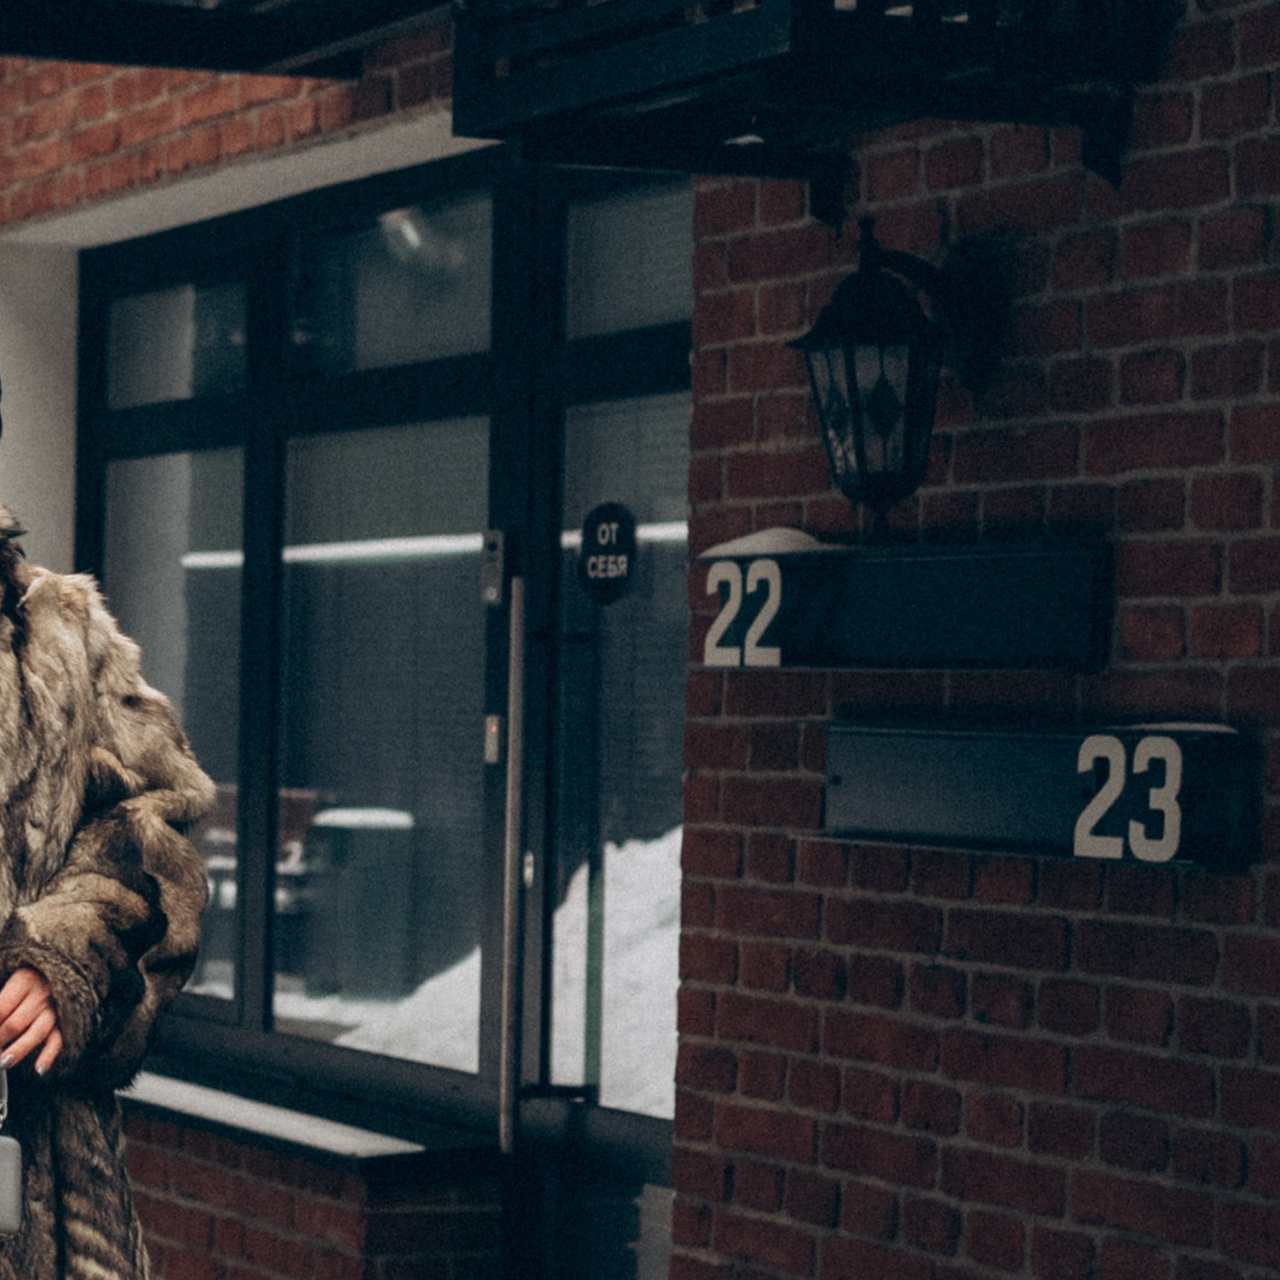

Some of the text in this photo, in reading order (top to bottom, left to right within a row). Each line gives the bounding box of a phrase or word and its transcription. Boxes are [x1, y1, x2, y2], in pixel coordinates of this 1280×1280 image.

[587, 555, 628, 578] СЕБЯ
[597, 523, 619, 545] ОТ
[704, 560, 782, 667] 22
[1074, 735, 1183, 863] 23
